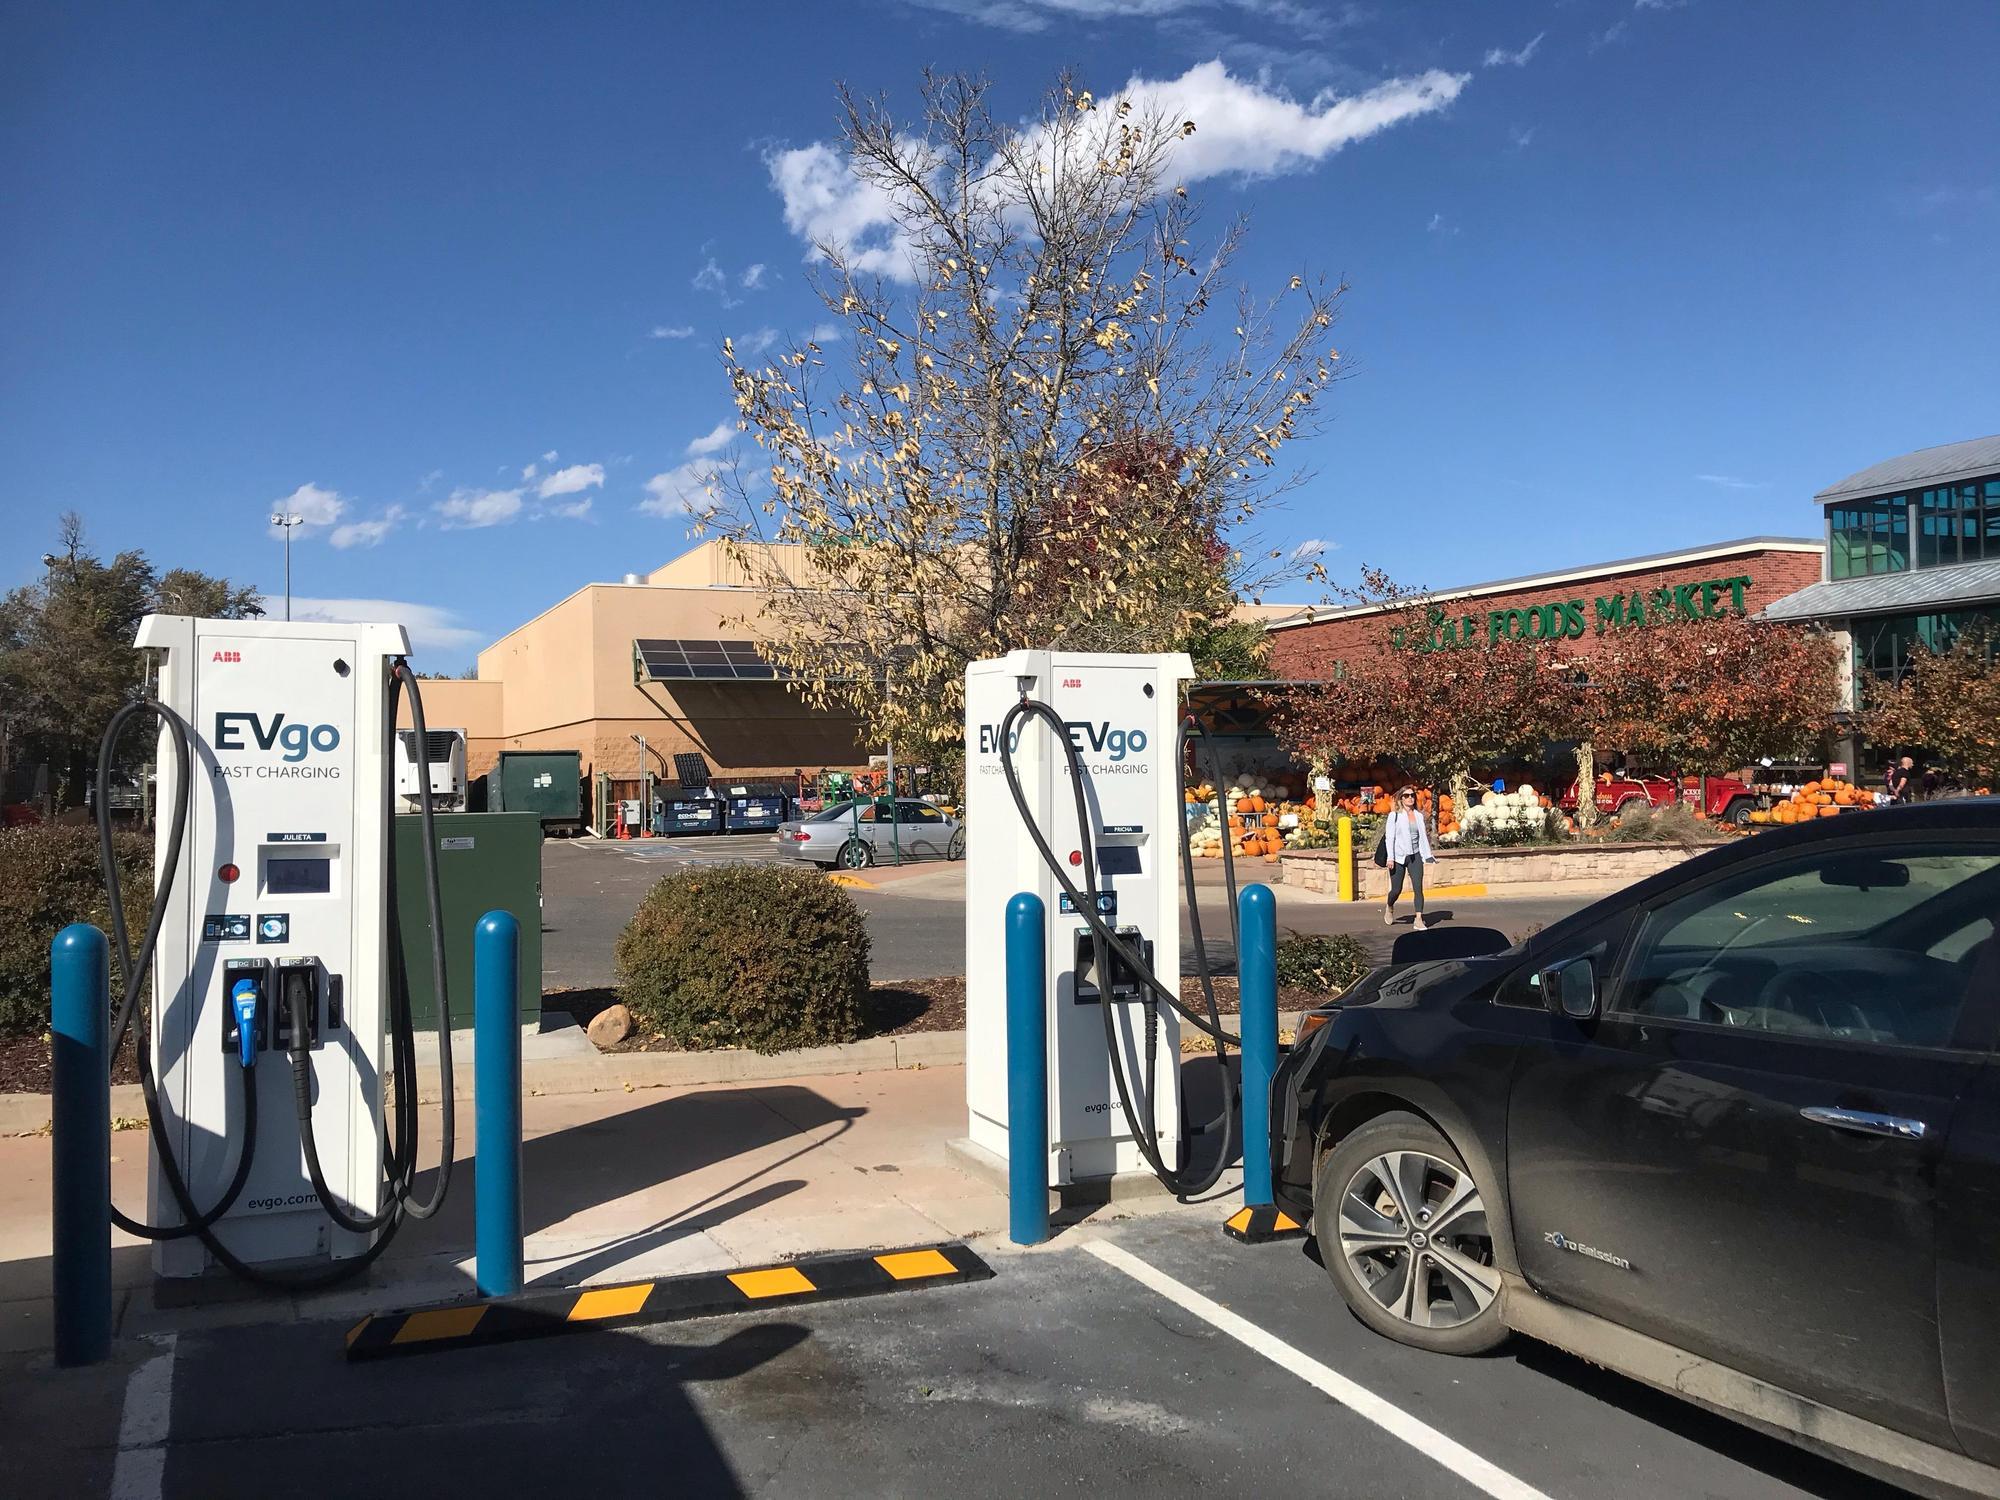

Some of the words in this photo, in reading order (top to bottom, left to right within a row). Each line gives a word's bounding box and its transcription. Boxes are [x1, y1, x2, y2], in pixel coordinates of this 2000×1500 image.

[1488, 599, 1585, 646] FOODS
[1595, 575, 1753, 636] MARKET
[212, 651, 242, 663] ABB
[1062, 679, 1082, 688] ABB
[215, 711, 341, 762] EVgo
[980, 724, 1017, 762] EVo
[1064, 721, 1147, 761] EVgo
[213, 766, 253, 779] FAST
[256, 765, 341, 779] CHARGING
[1063, 765, 1090, 776] FST
[1092, 764, 1148, 775] CHARGING
[305, 957, 314, 965] 2
[1084, 1101, 1123, 1114] evgo.co
[248, 1194, 318, 1210] evgo.com
